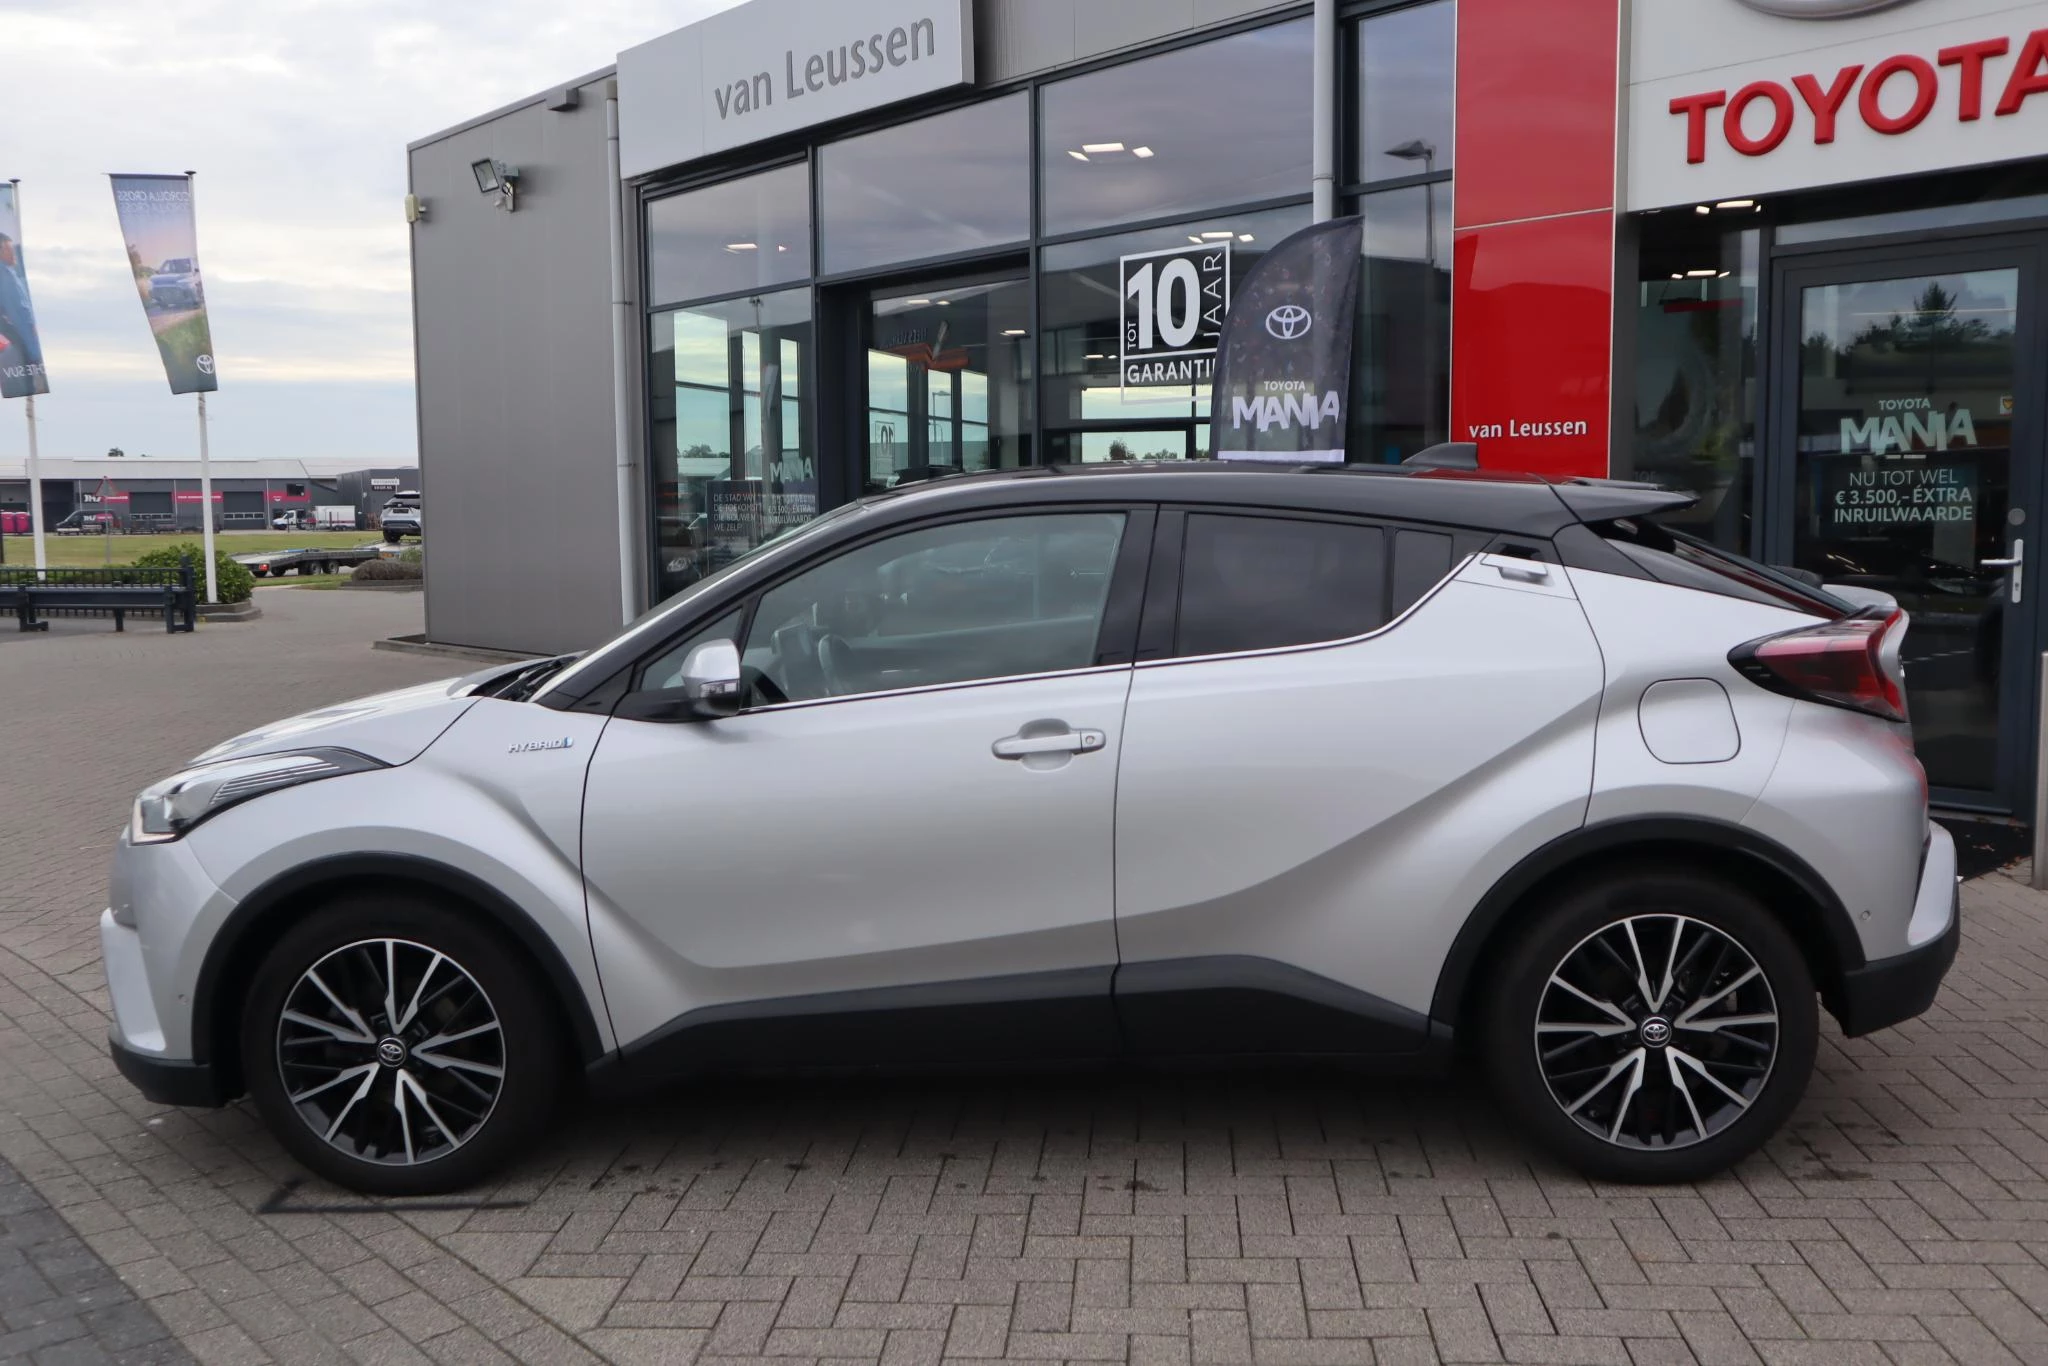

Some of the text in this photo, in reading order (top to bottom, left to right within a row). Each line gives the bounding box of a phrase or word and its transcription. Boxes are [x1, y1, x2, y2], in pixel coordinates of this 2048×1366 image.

[714, 17, 935, 120] van Leussen
[1669, 28, 2048, 164] TOYOTA
[1127, 252, 1222, 350] TOT 10 JAAR
[1127, 358, 1216, 383] GARANTI
[1264, 380, 1306, 392] TOYOTA
[1232, 390, 1340, 432] MANIA
[1879, 398, 1931, 410] TOYOTA
[1469, 417, 1588, 438] van Leussen
[1840, 408, 1977, 456] MANIA
[1849, 469, 1958, 486] NU TOT WEL
[1913, 485, 1972, 503] ÉXTRA
[1834, 506, 1973, 523] INRUILWAARDE
[508, 739, 562, 753] HYBRID
